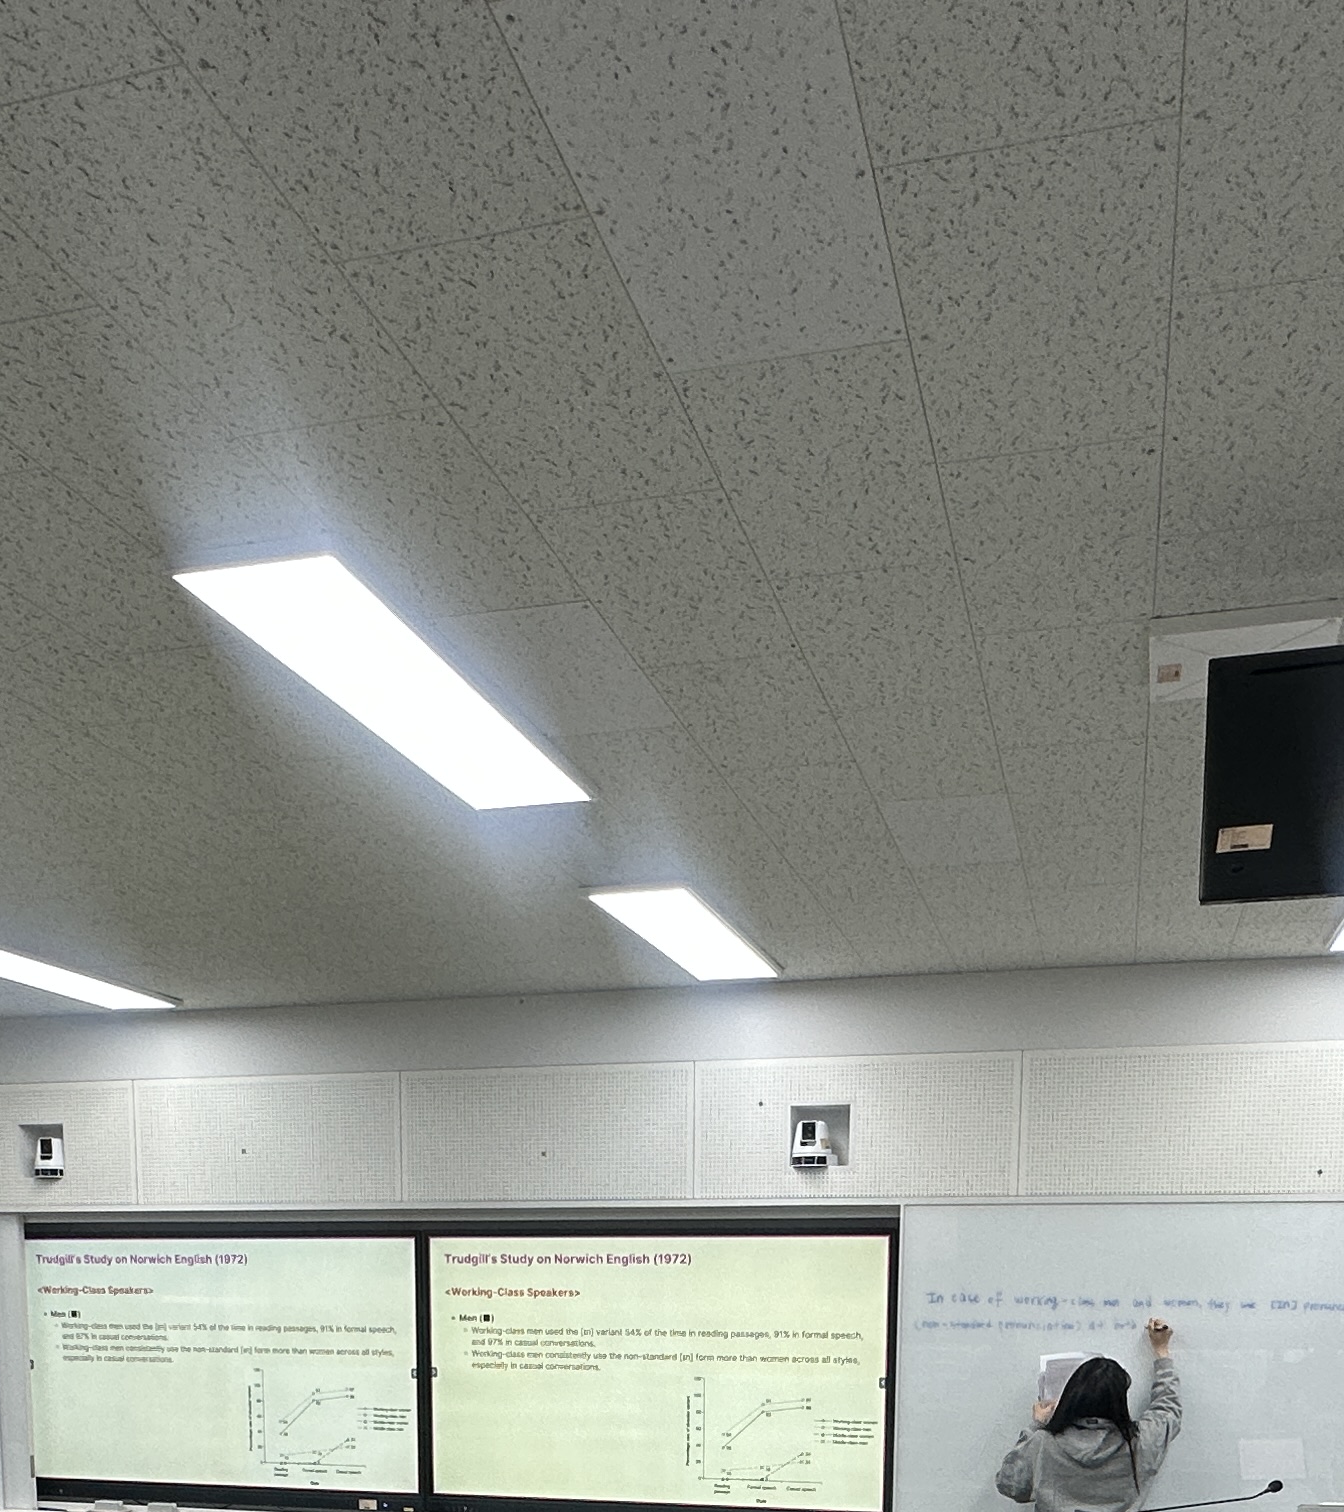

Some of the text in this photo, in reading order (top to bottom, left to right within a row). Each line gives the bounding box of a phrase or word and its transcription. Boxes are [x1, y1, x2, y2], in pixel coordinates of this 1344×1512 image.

[36, 1254, 247, 1266] Trudgill's Study on Norwich English (1972)
[445, 1253, 691, 1266] Trudgill's Study on Norwich English (1972)
[445, 1288, 580, 1298] <Working-Class Speakers>
[459, 1314, 477, 1322] Men
[546, 1327, 563, 1335] used
[566, 1327, 578, 1335] the
[596, 1328, 622, 1336] variant
[625, 1328, 642, 1337] 54%
[644, 1328, 652, 1337] of
[655, 1329, 667, 1337] the
[698, 1330, 728, 1339] reading
[774, 1330, 790, 1339] 91%
[793, 1330, 800, 1338] in
[802, 1330, 828, 1339] formal
[831, 1331, 863, 1340] speech,
[609, 1352, 621, 1360] the
[717, 1354, 737, 1362] more
[740, 1354, 757, 1362] than
